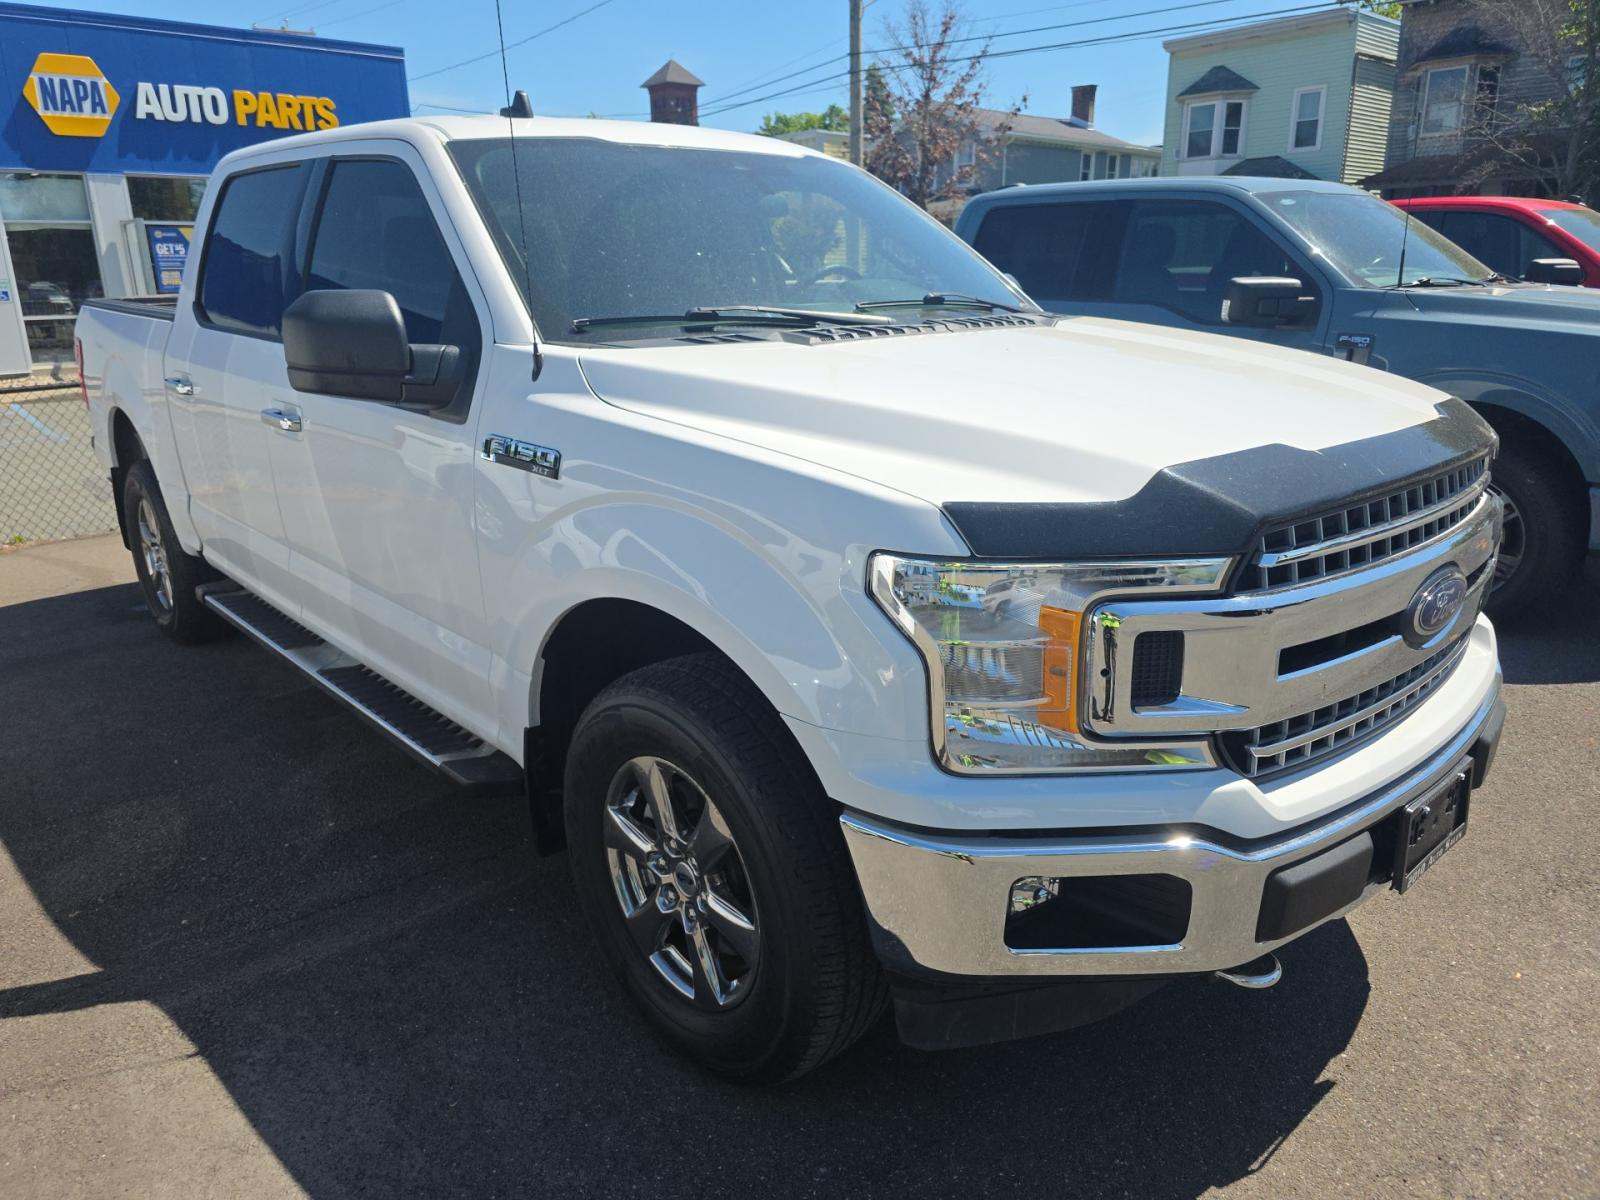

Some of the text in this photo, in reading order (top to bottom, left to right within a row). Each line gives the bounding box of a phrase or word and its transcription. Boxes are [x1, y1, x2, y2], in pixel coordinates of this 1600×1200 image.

[38, 76, 108, 114] NAPA
[135, 81, 340, 132] AUTO PARTS
[155, 243, 175, 255] GET
[531, 465, 549, 475] XLT
[1429, 586, 1464, 626] Ford
